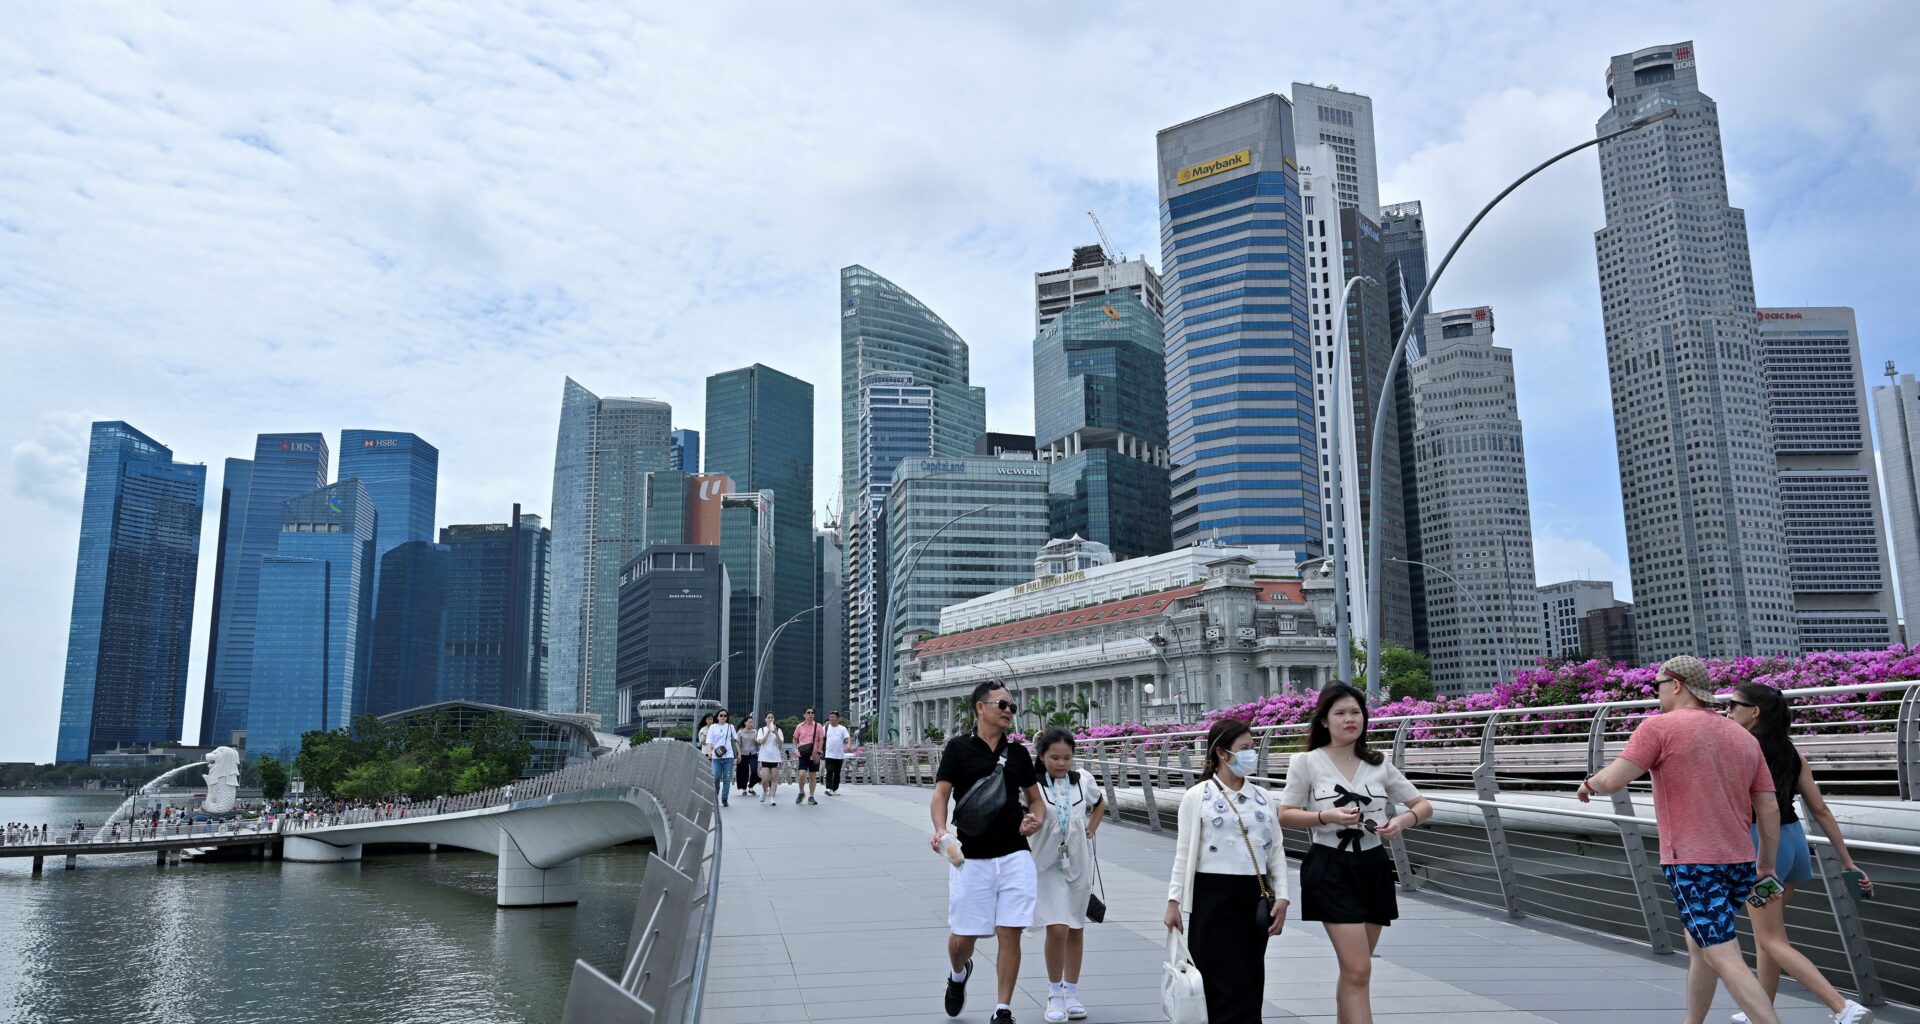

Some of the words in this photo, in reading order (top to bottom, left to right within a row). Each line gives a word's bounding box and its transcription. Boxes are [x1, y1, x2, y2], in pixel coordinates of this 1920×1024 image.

[1673, 60, 1695, 70] UOB
[1192, 154, 1242, 177] Maybank
[842, 308, 857, 318] ANZ
[291, 442, 313, 451] DBS
[376, 439, 398, 447] HSBC
[920, 460, 965, 474] CapitaLand
[996, 465, 1040, 476] wework
[1014, 585, 1025, 595] THE
[1026, 577, 1061, 592] FULLERTON
[1064, 571, 1085, 583] HOTEL
